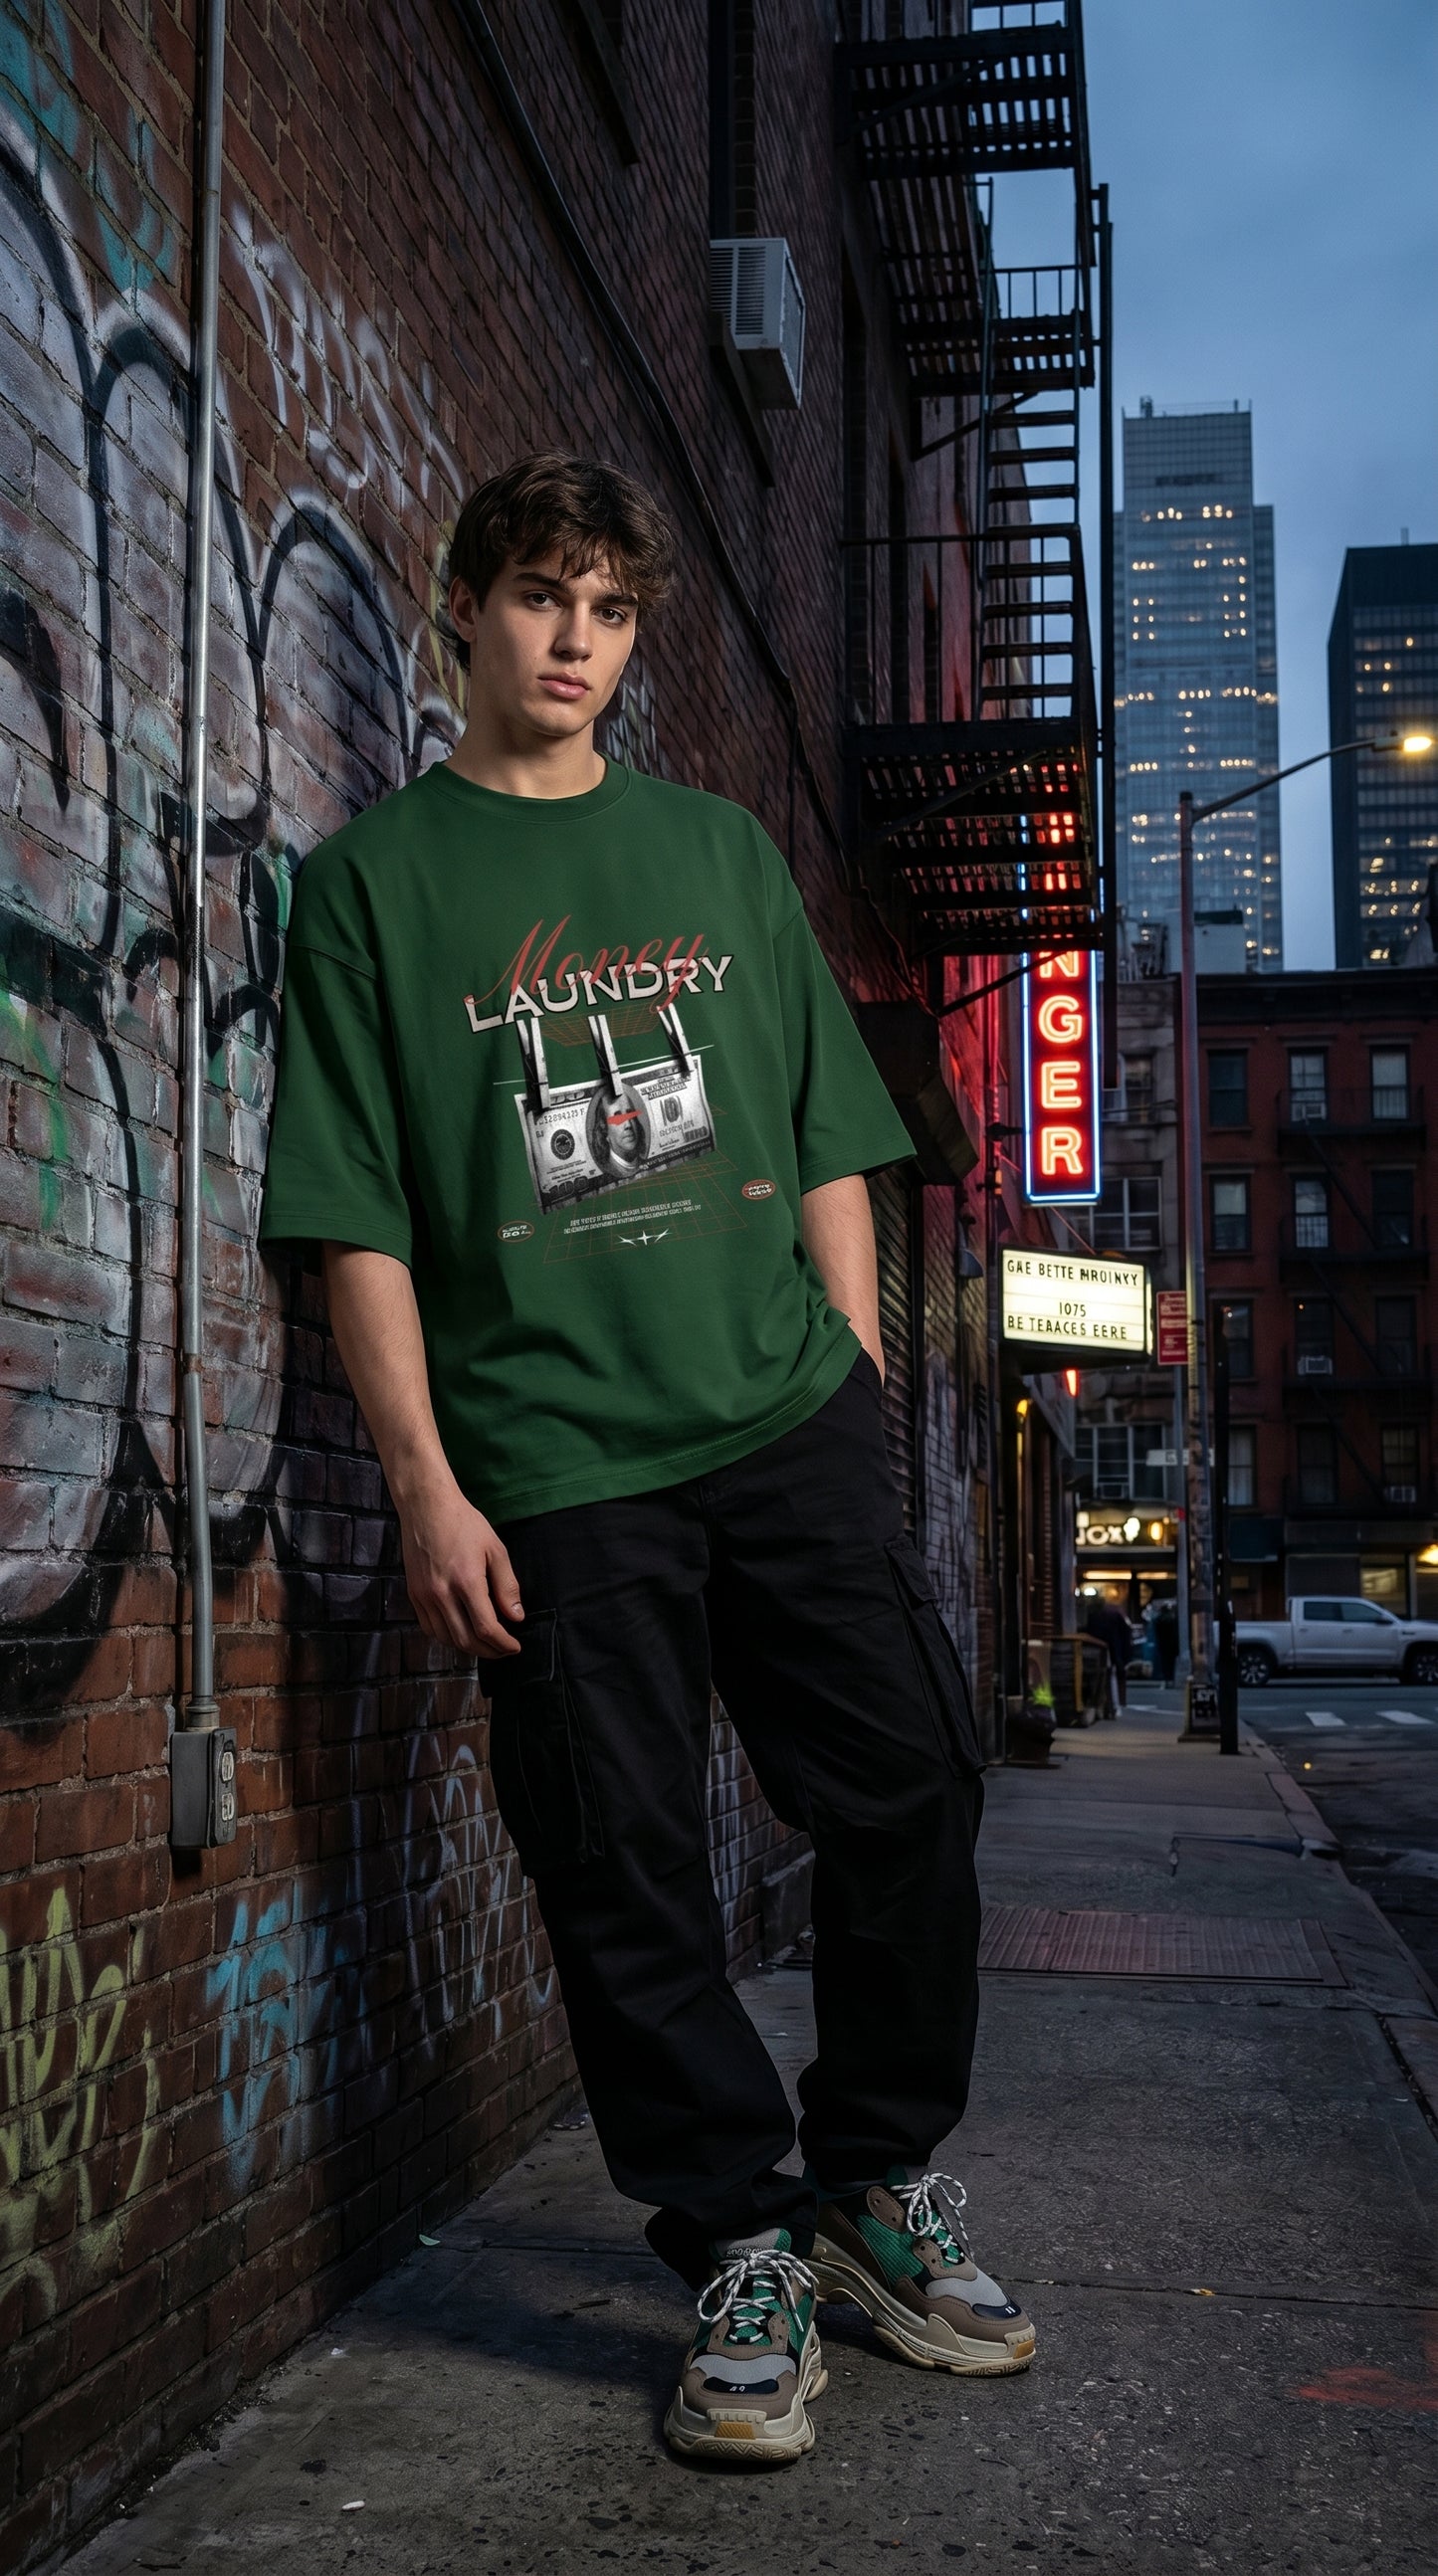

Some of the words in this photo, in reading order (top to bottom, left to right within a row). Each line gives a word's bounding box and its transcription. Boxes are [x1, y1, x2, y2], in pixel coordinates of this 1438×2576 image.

[464, 914, 709, 1014] Money
[464, 954, 734, 1033] LAUNDRY
[1038, 1263, 1074, 1280] BETTE
[1059, 1301, 1087, 1317] 1075
[1007, 1315, 1023, 1330] BE
